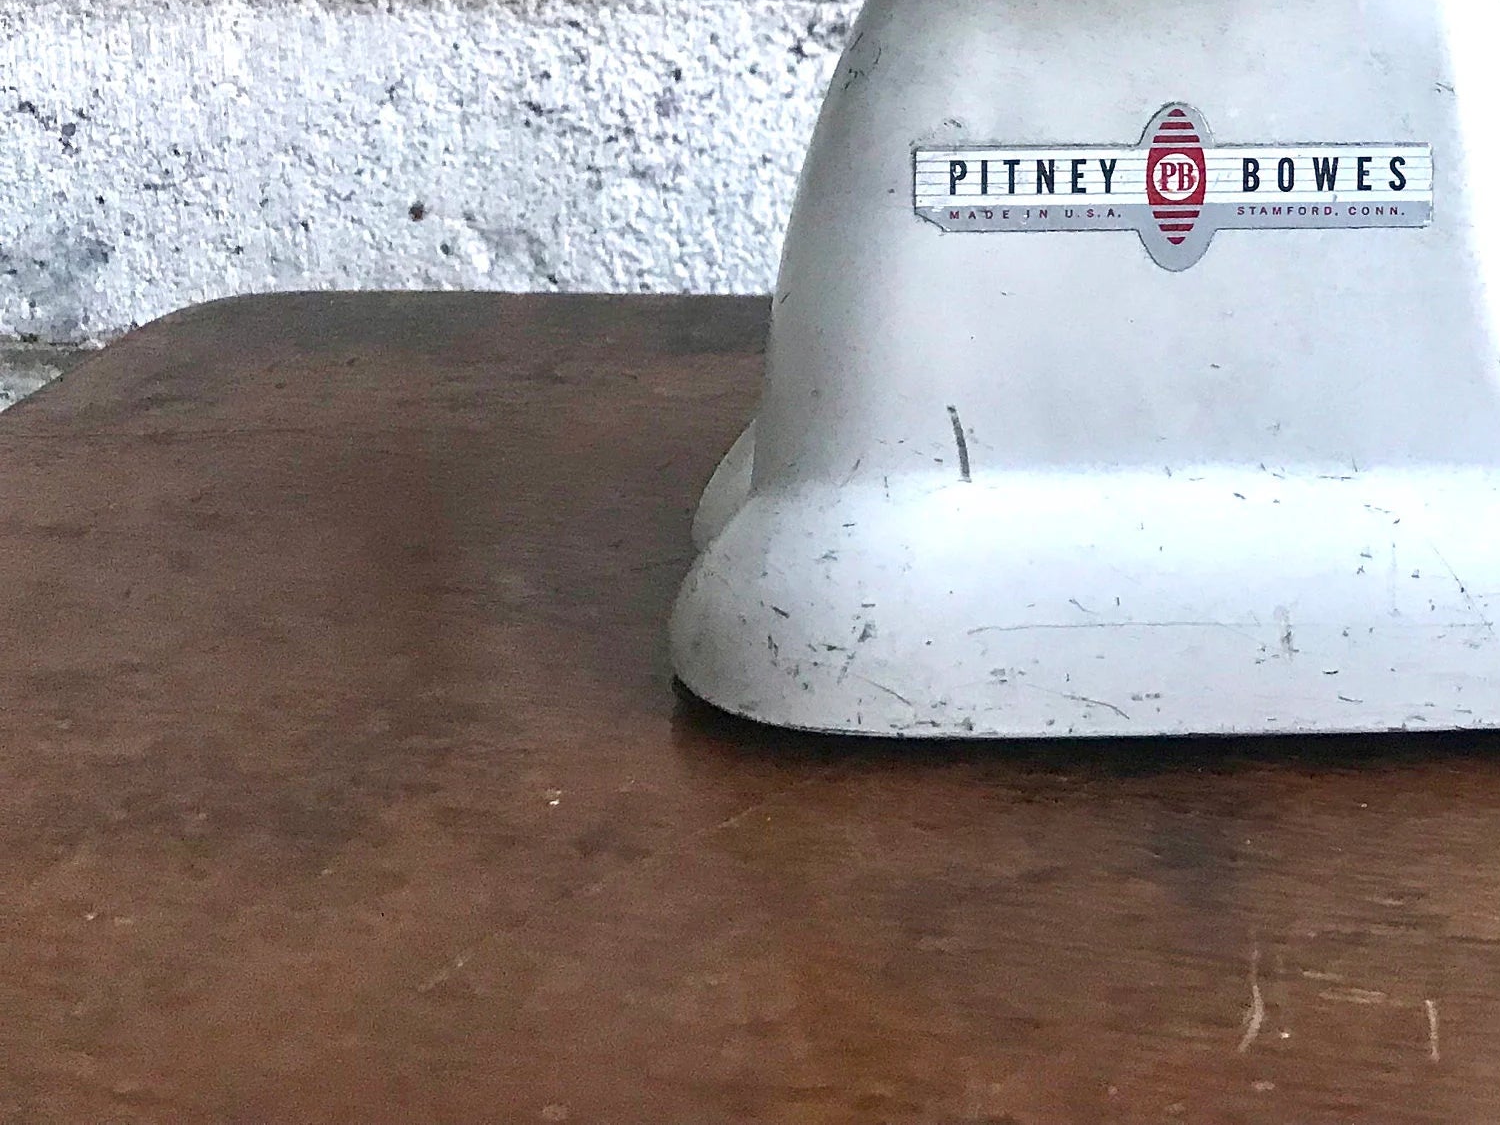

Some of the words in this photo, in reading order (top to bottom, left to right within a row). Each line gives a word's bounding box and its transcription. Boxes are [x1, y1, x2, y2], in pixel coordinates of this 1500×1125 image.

[949, 158, 1117, 196] PITNEY
[1159, 161, 1195, 192] PB
[1243, 156, 1408, 193] BOWES
[949, 210, 1012, 220] MADE
[1026, 209, 1049, 219] IN
[1064, 208, 1122, 219] U.S.A.
[1349, 206, 1406, 216] CONN.
